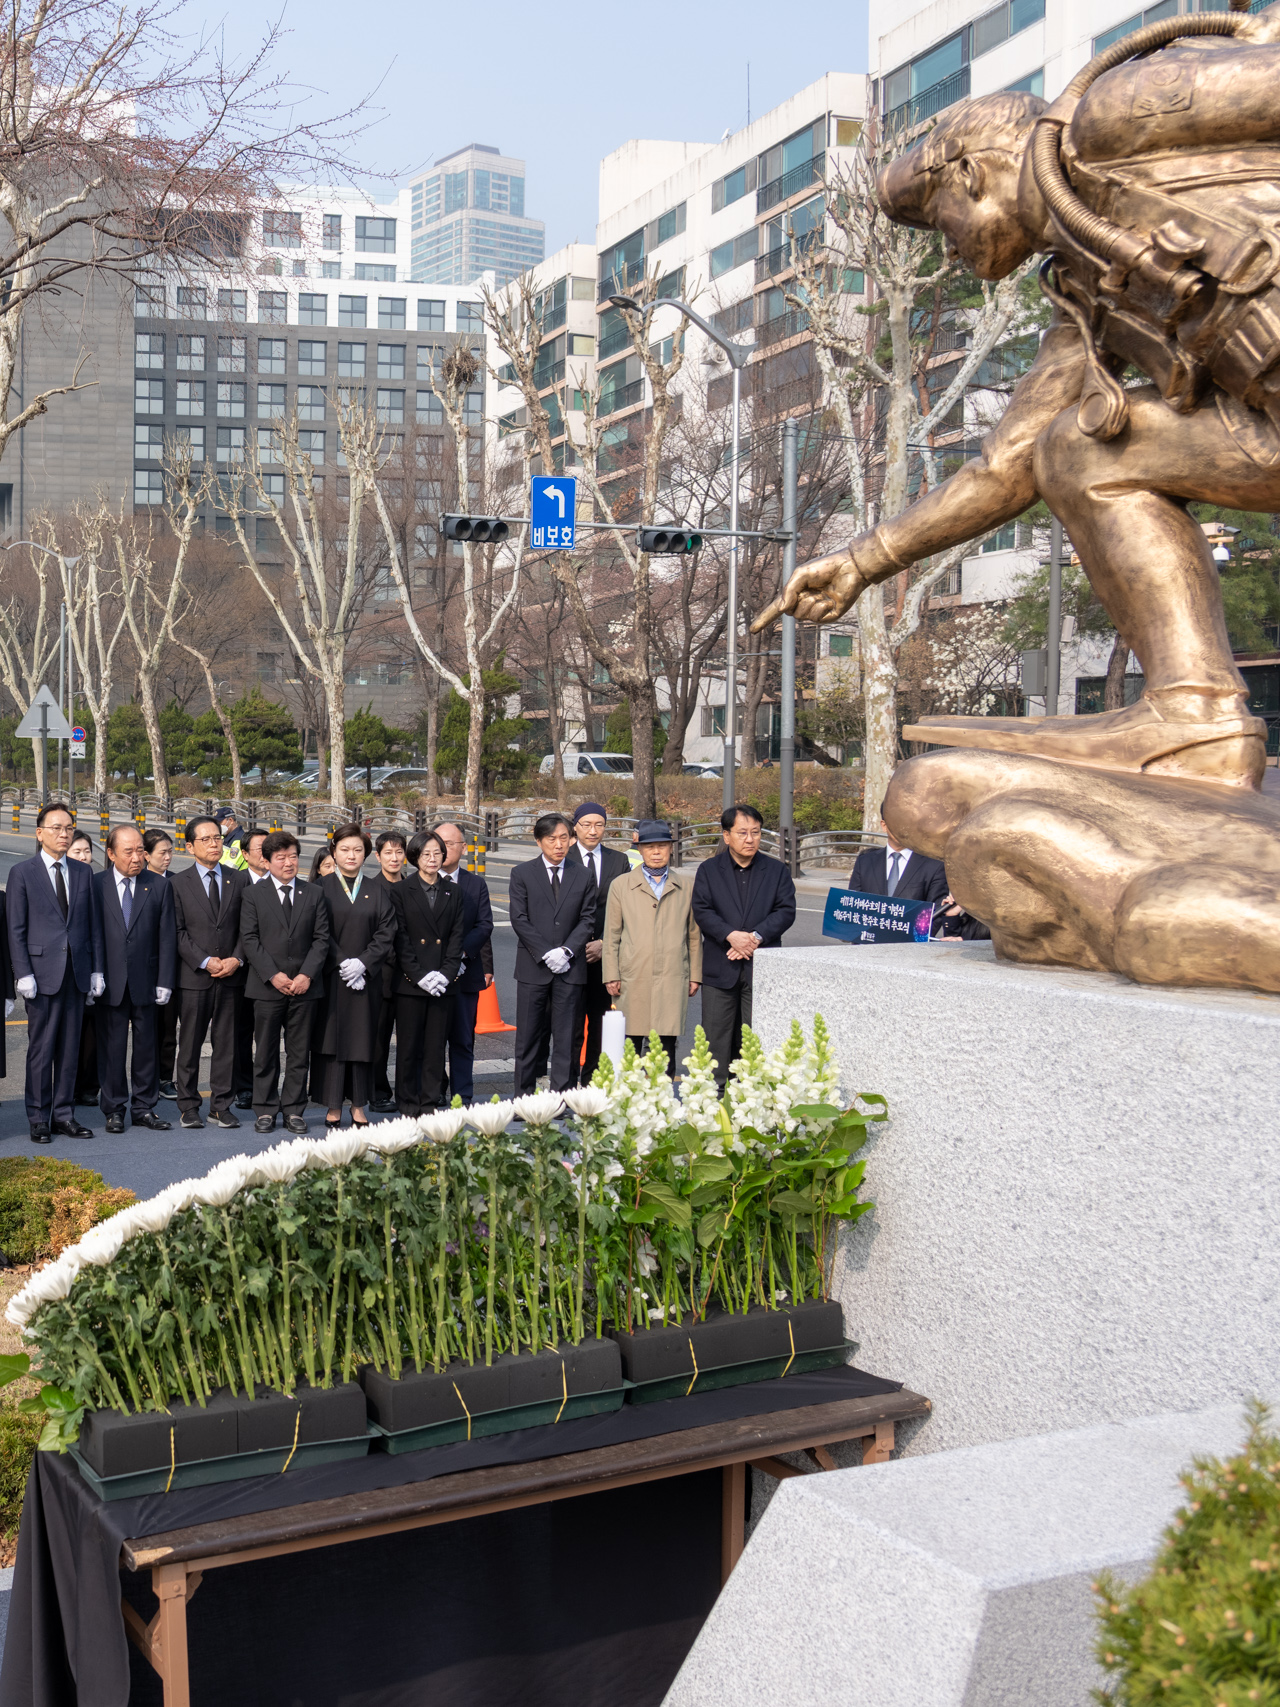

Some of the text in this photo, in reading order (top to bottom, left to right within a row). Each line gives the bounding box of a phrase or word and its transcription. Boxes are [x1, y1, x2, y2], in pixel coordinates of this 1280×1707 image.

[533, 526, 572, 547] 비보호
[880, 902, 888, 914] 날
[888, 904, 905, 917] 기념식
[891, 919, 910, 934] 추모식
